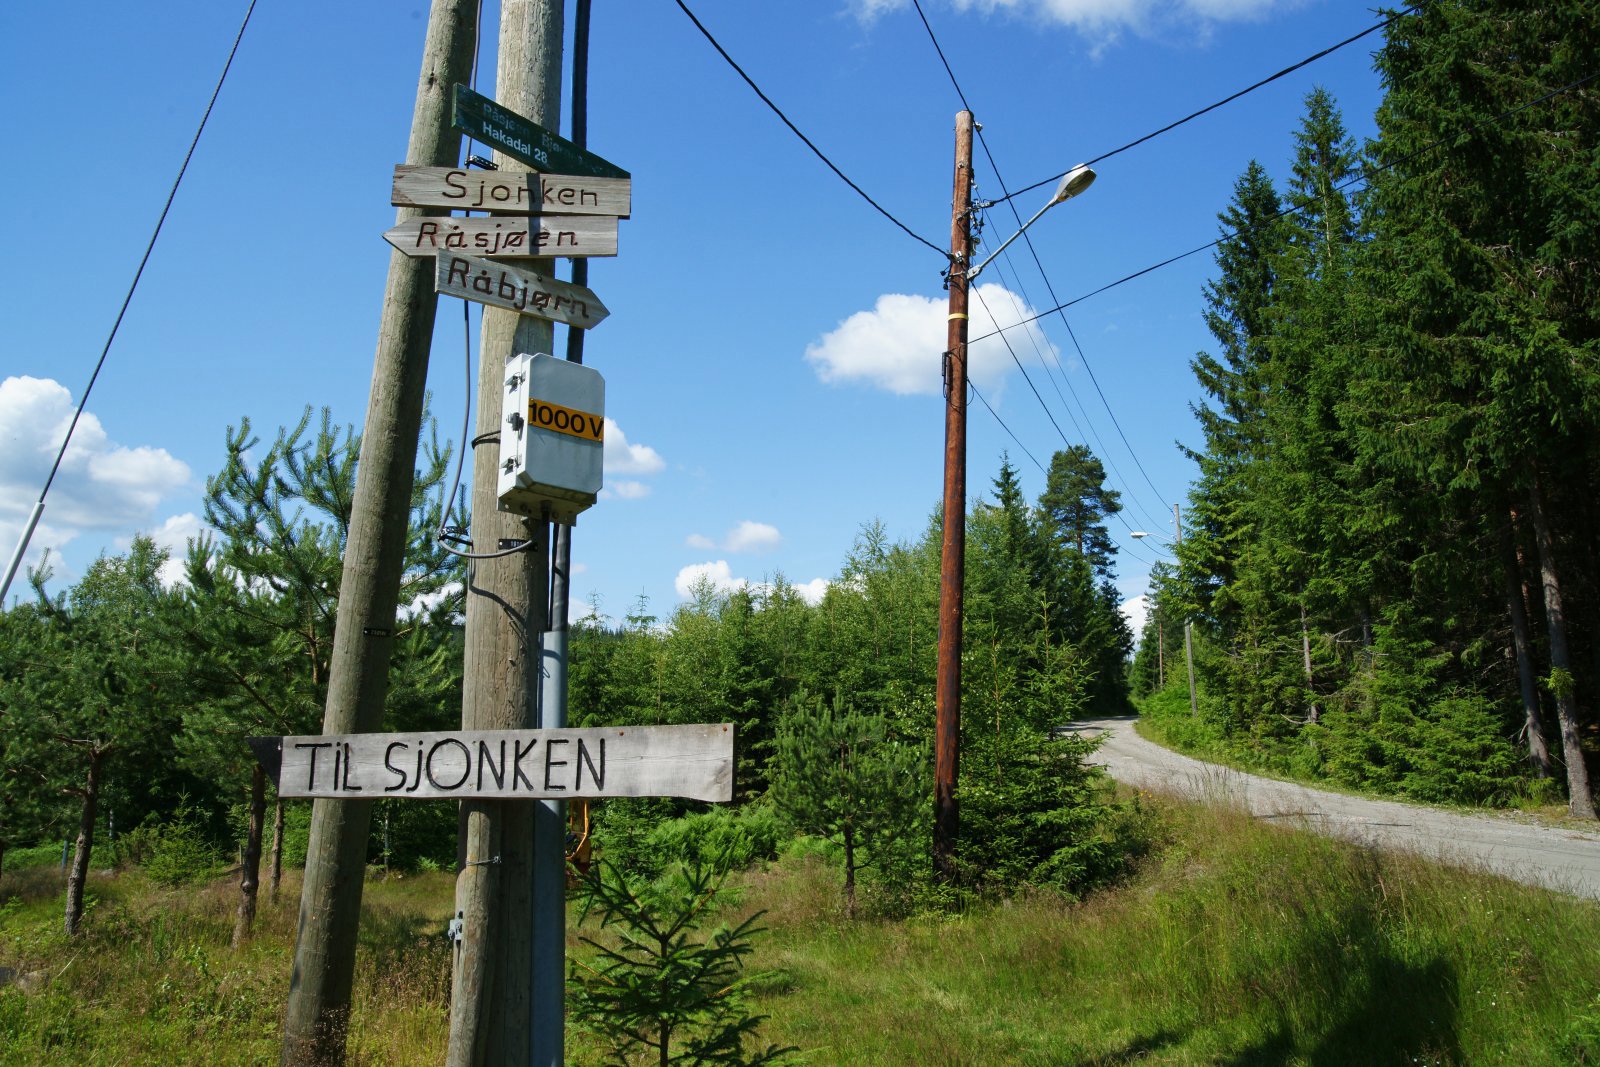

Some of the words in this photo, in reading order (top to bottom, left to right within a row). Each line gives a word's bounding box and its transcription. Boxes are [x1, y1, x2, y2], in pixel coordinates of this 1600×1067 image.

[482, 121, 531, 157] Hakadal
[534, 147, 548, 164] 28
[442, 171, 599, 207] Sjonken
[415, 222, 578, 255] Råsjøen
[447, 256, 589, 319] Råbjørn
[529, 402, 586, 434] 1000
[589, 417, 604, 438] V
